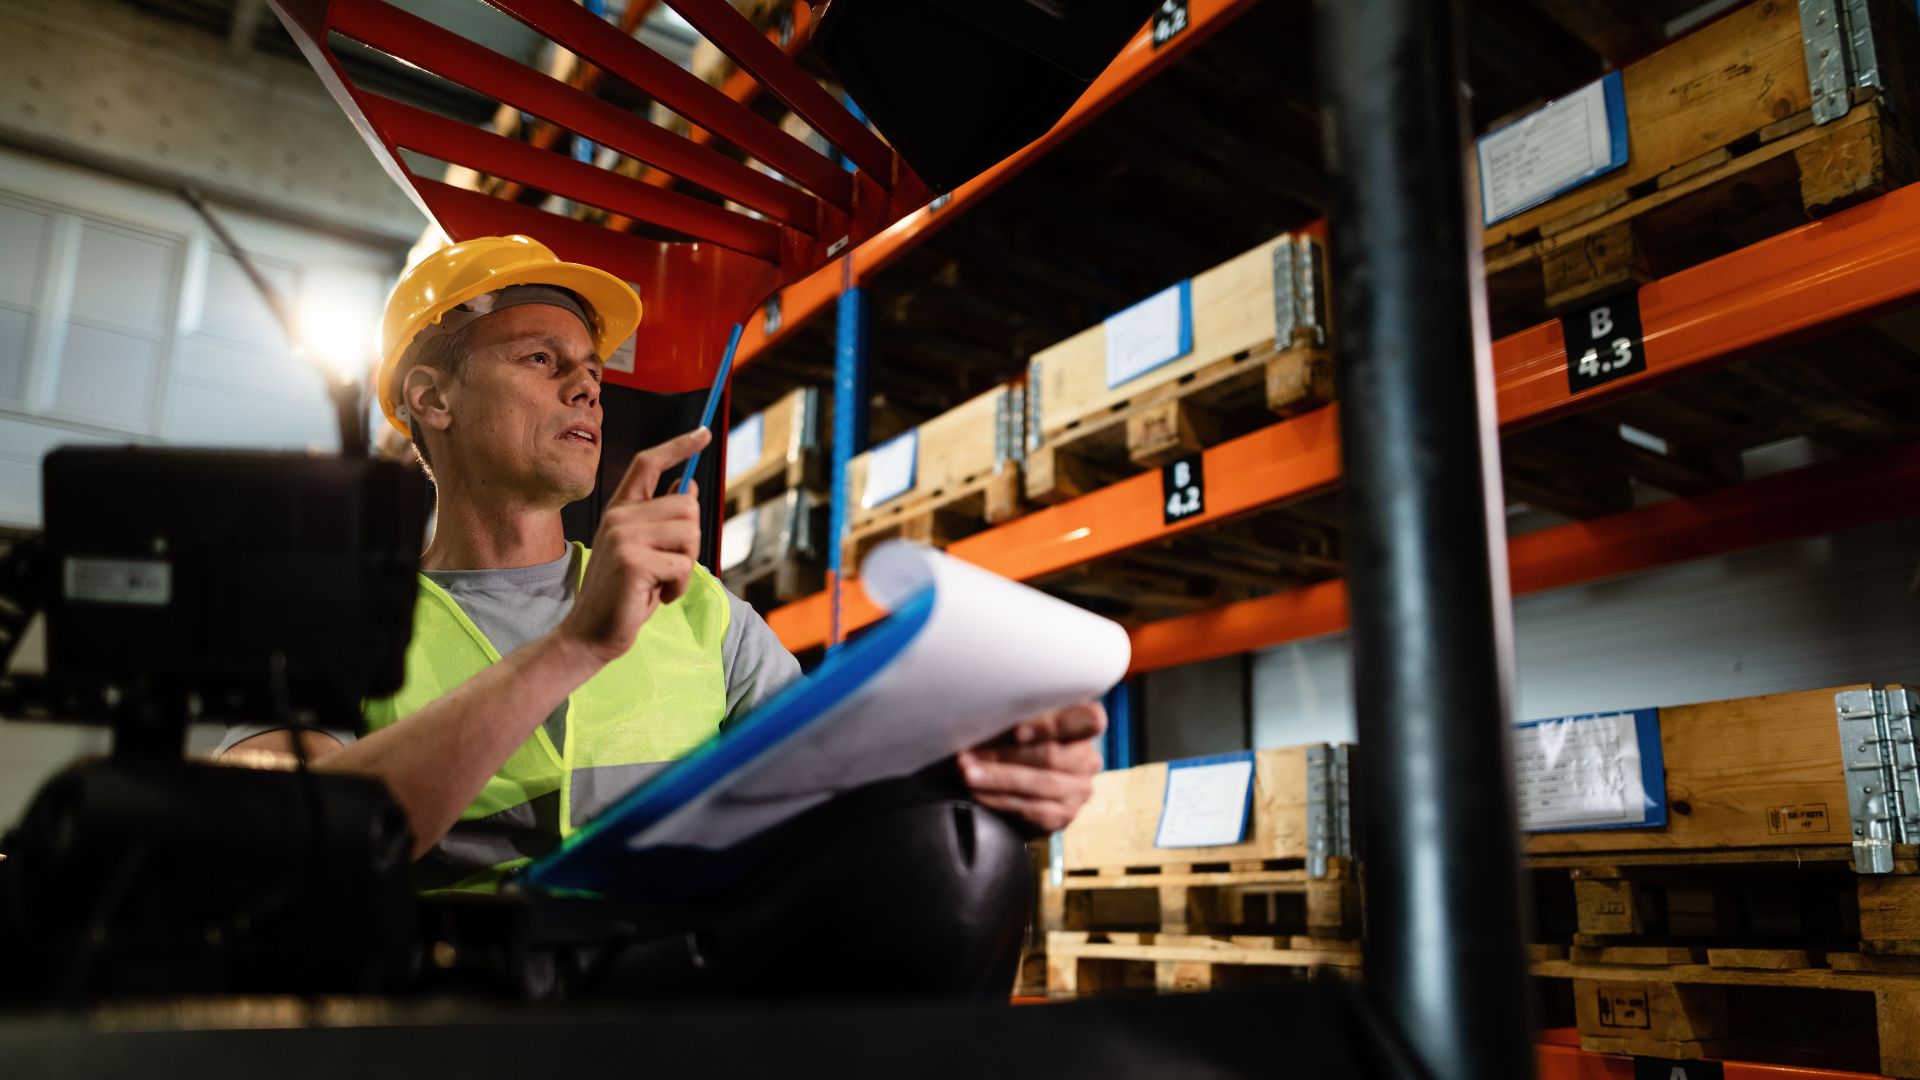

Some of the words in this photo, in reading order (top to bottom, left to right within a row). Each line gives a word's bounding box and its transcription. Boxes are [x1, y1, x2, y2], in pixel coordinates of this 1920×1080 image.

[1590, 306, 1614, 339] B
[1578, 336, 1632, 377] 4.3
[1174, 461, 1191, 489] B
[1167, 485, 1201, 517] 4.2
